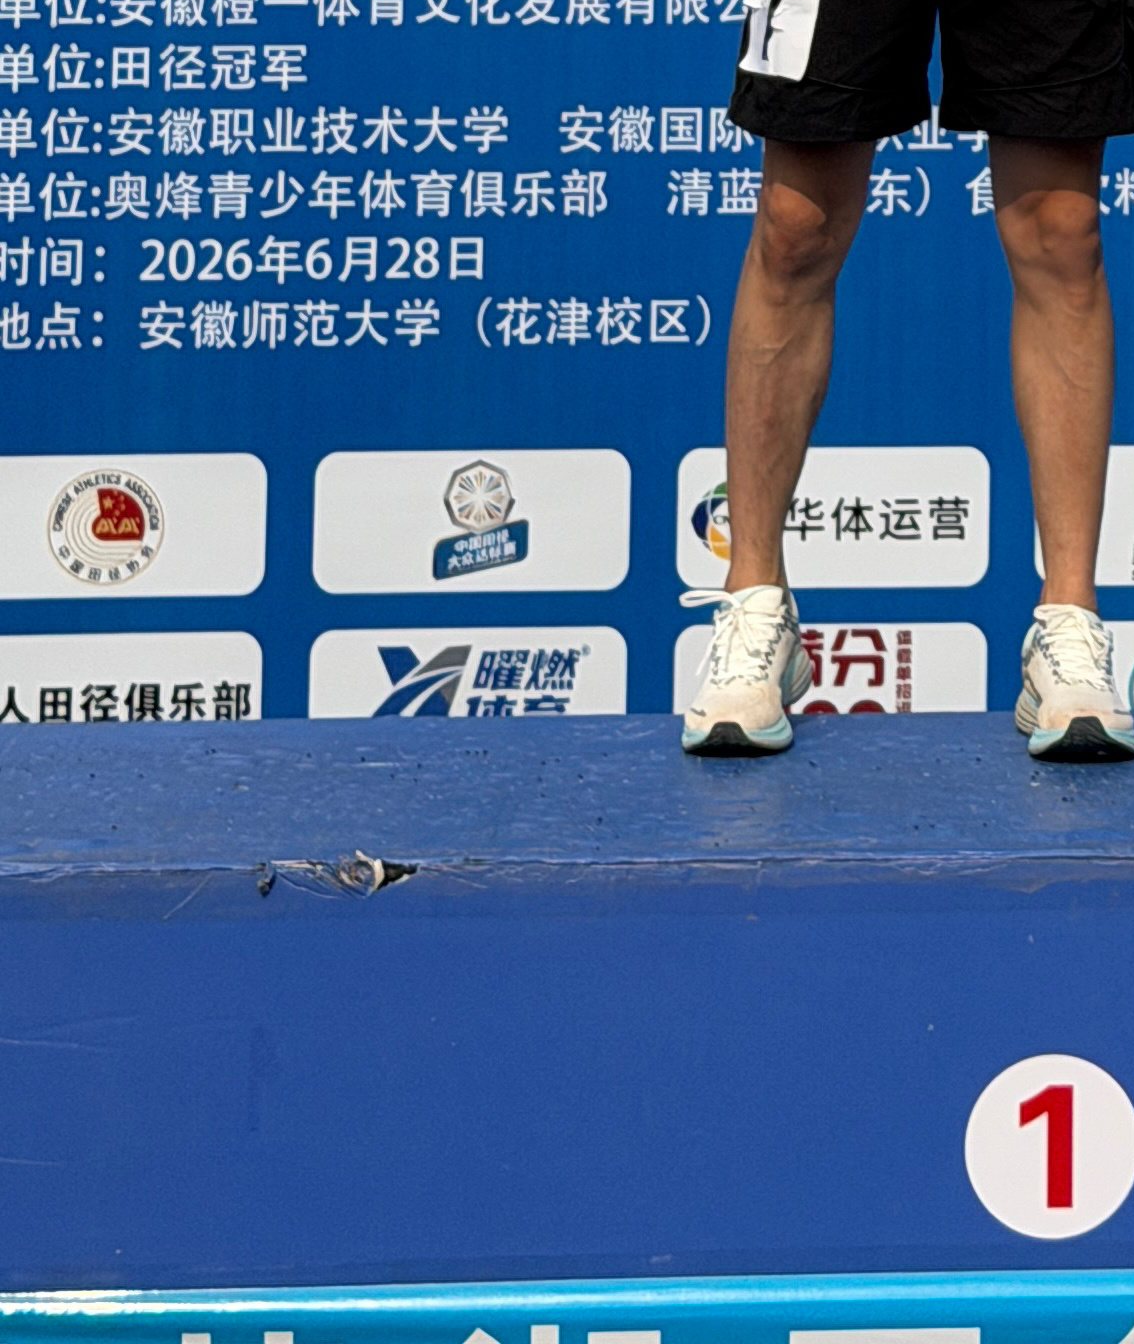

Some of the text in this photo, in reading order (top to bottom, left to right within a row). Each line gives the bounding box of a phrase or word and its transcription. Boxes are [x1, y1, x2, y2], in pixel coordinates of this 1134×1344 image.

[0, 42, 309, 95] 单位:田径冠军
[0, 105, 510, 159] 单位:安徽职业技术大学
[1018, 1084, 1075, 1209] 1
